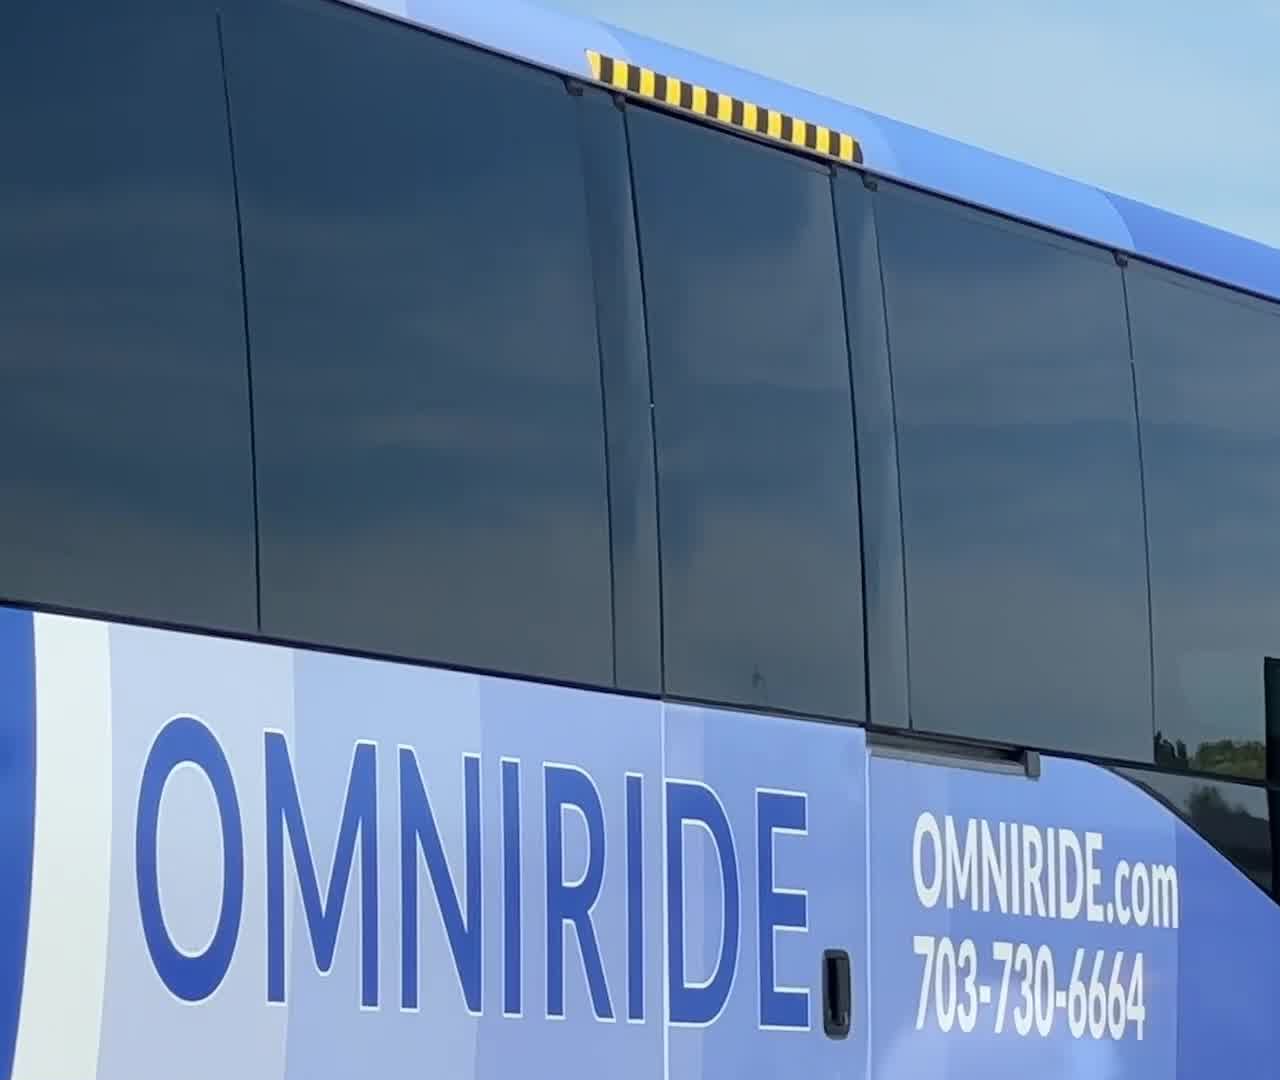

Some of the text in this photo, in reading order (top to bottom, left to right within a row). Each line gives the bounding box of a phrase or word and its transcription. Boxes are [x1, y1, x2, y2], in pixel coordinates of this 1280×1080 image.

[135, 712, 811, 1031] OMNIRIDE
[913, 811, 1179, 928] OMNIRIDE.com
[913, 936, 1146, 1041] 703-730-6664
